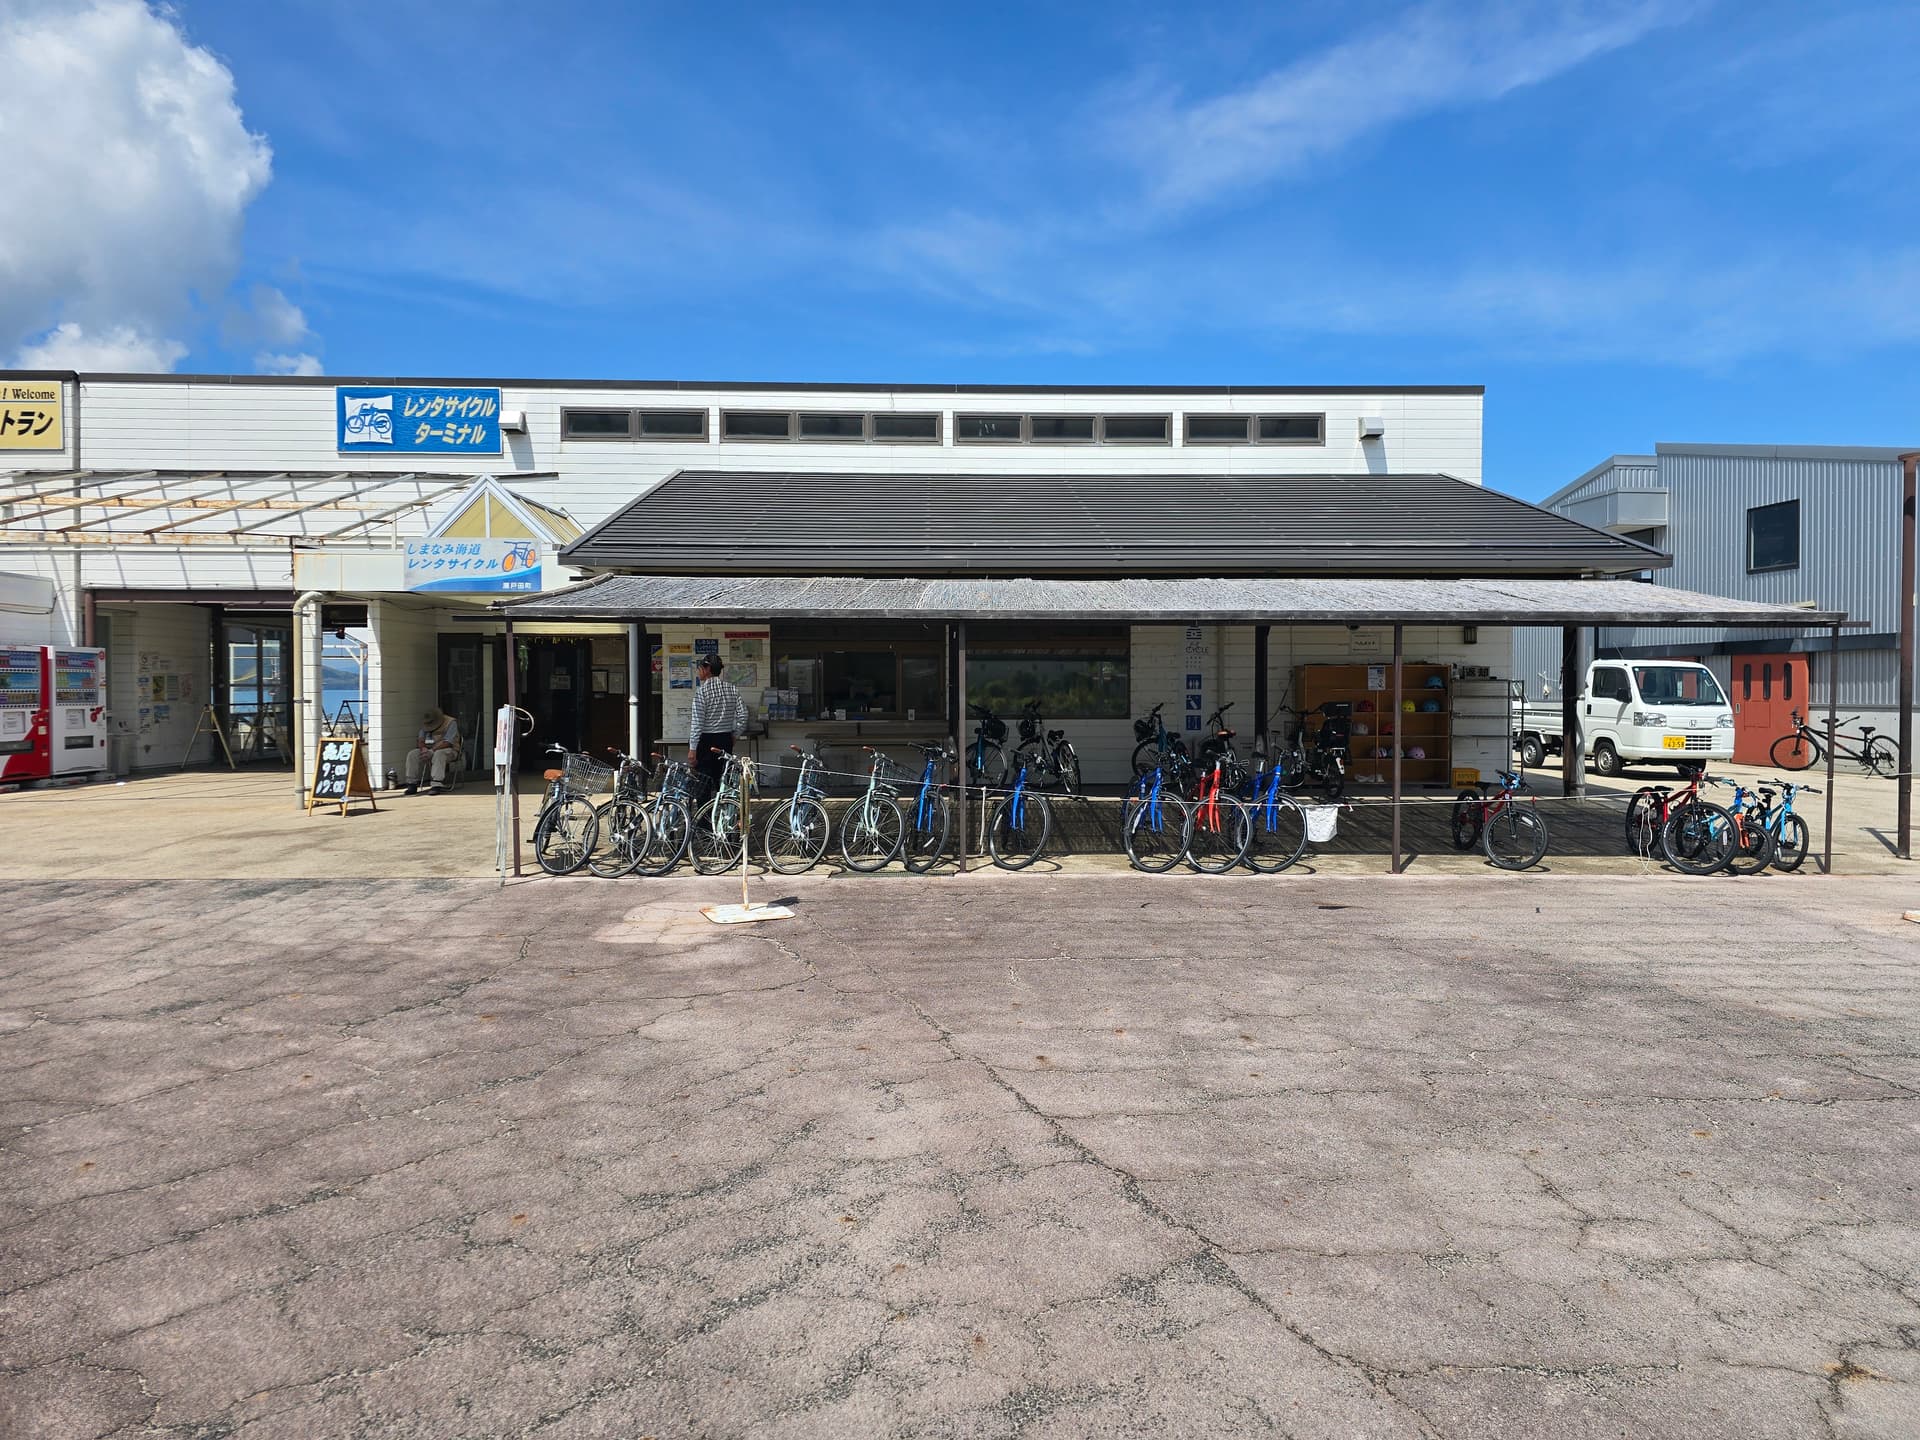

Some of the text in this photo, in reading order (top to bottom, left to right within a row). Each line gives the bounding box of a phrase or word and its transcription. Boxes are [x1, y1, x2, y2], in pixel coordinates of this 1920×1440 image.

[12, 388, 55, 399] Welcome
[403, 394, 496, 417] レンタサイクル
[0, 410, 53, 435] トラン
[415, 422, 486, 445] ターミナル
[407, 543, 481, 556] しまなみ海道
[407, 558, 499, 570] レンタサイクル
[322, 762, 348, 777] 9:00
